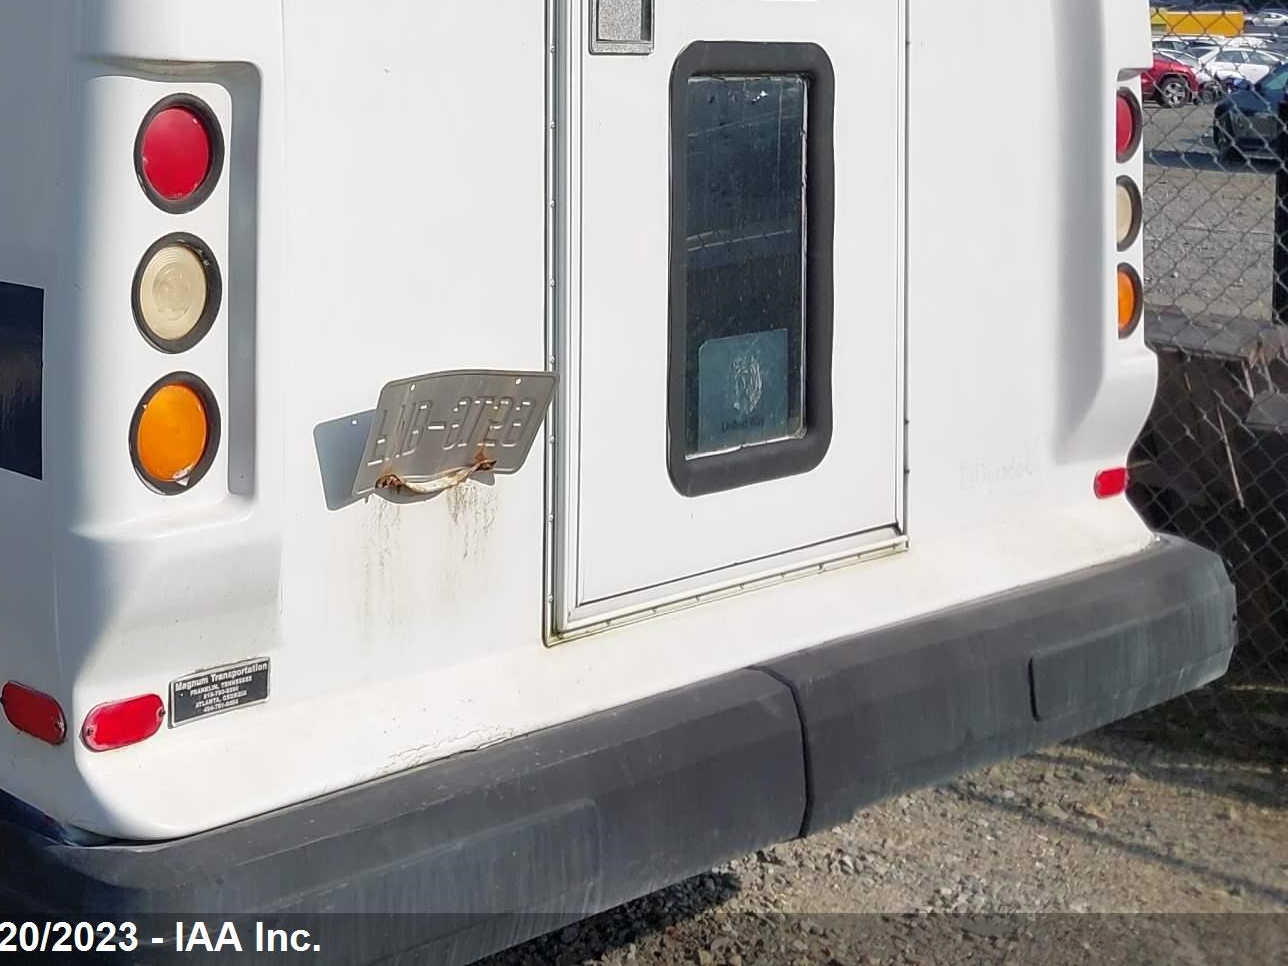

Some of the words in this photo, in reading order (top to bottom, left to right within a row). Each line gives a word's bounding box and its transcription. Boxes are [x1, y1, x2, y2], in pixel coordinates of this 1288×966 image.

[175, 677, 209, 691] Magnum
[211, 663, 267, 682] Transportation
[223, 690, 248, 701] GEORGIA
